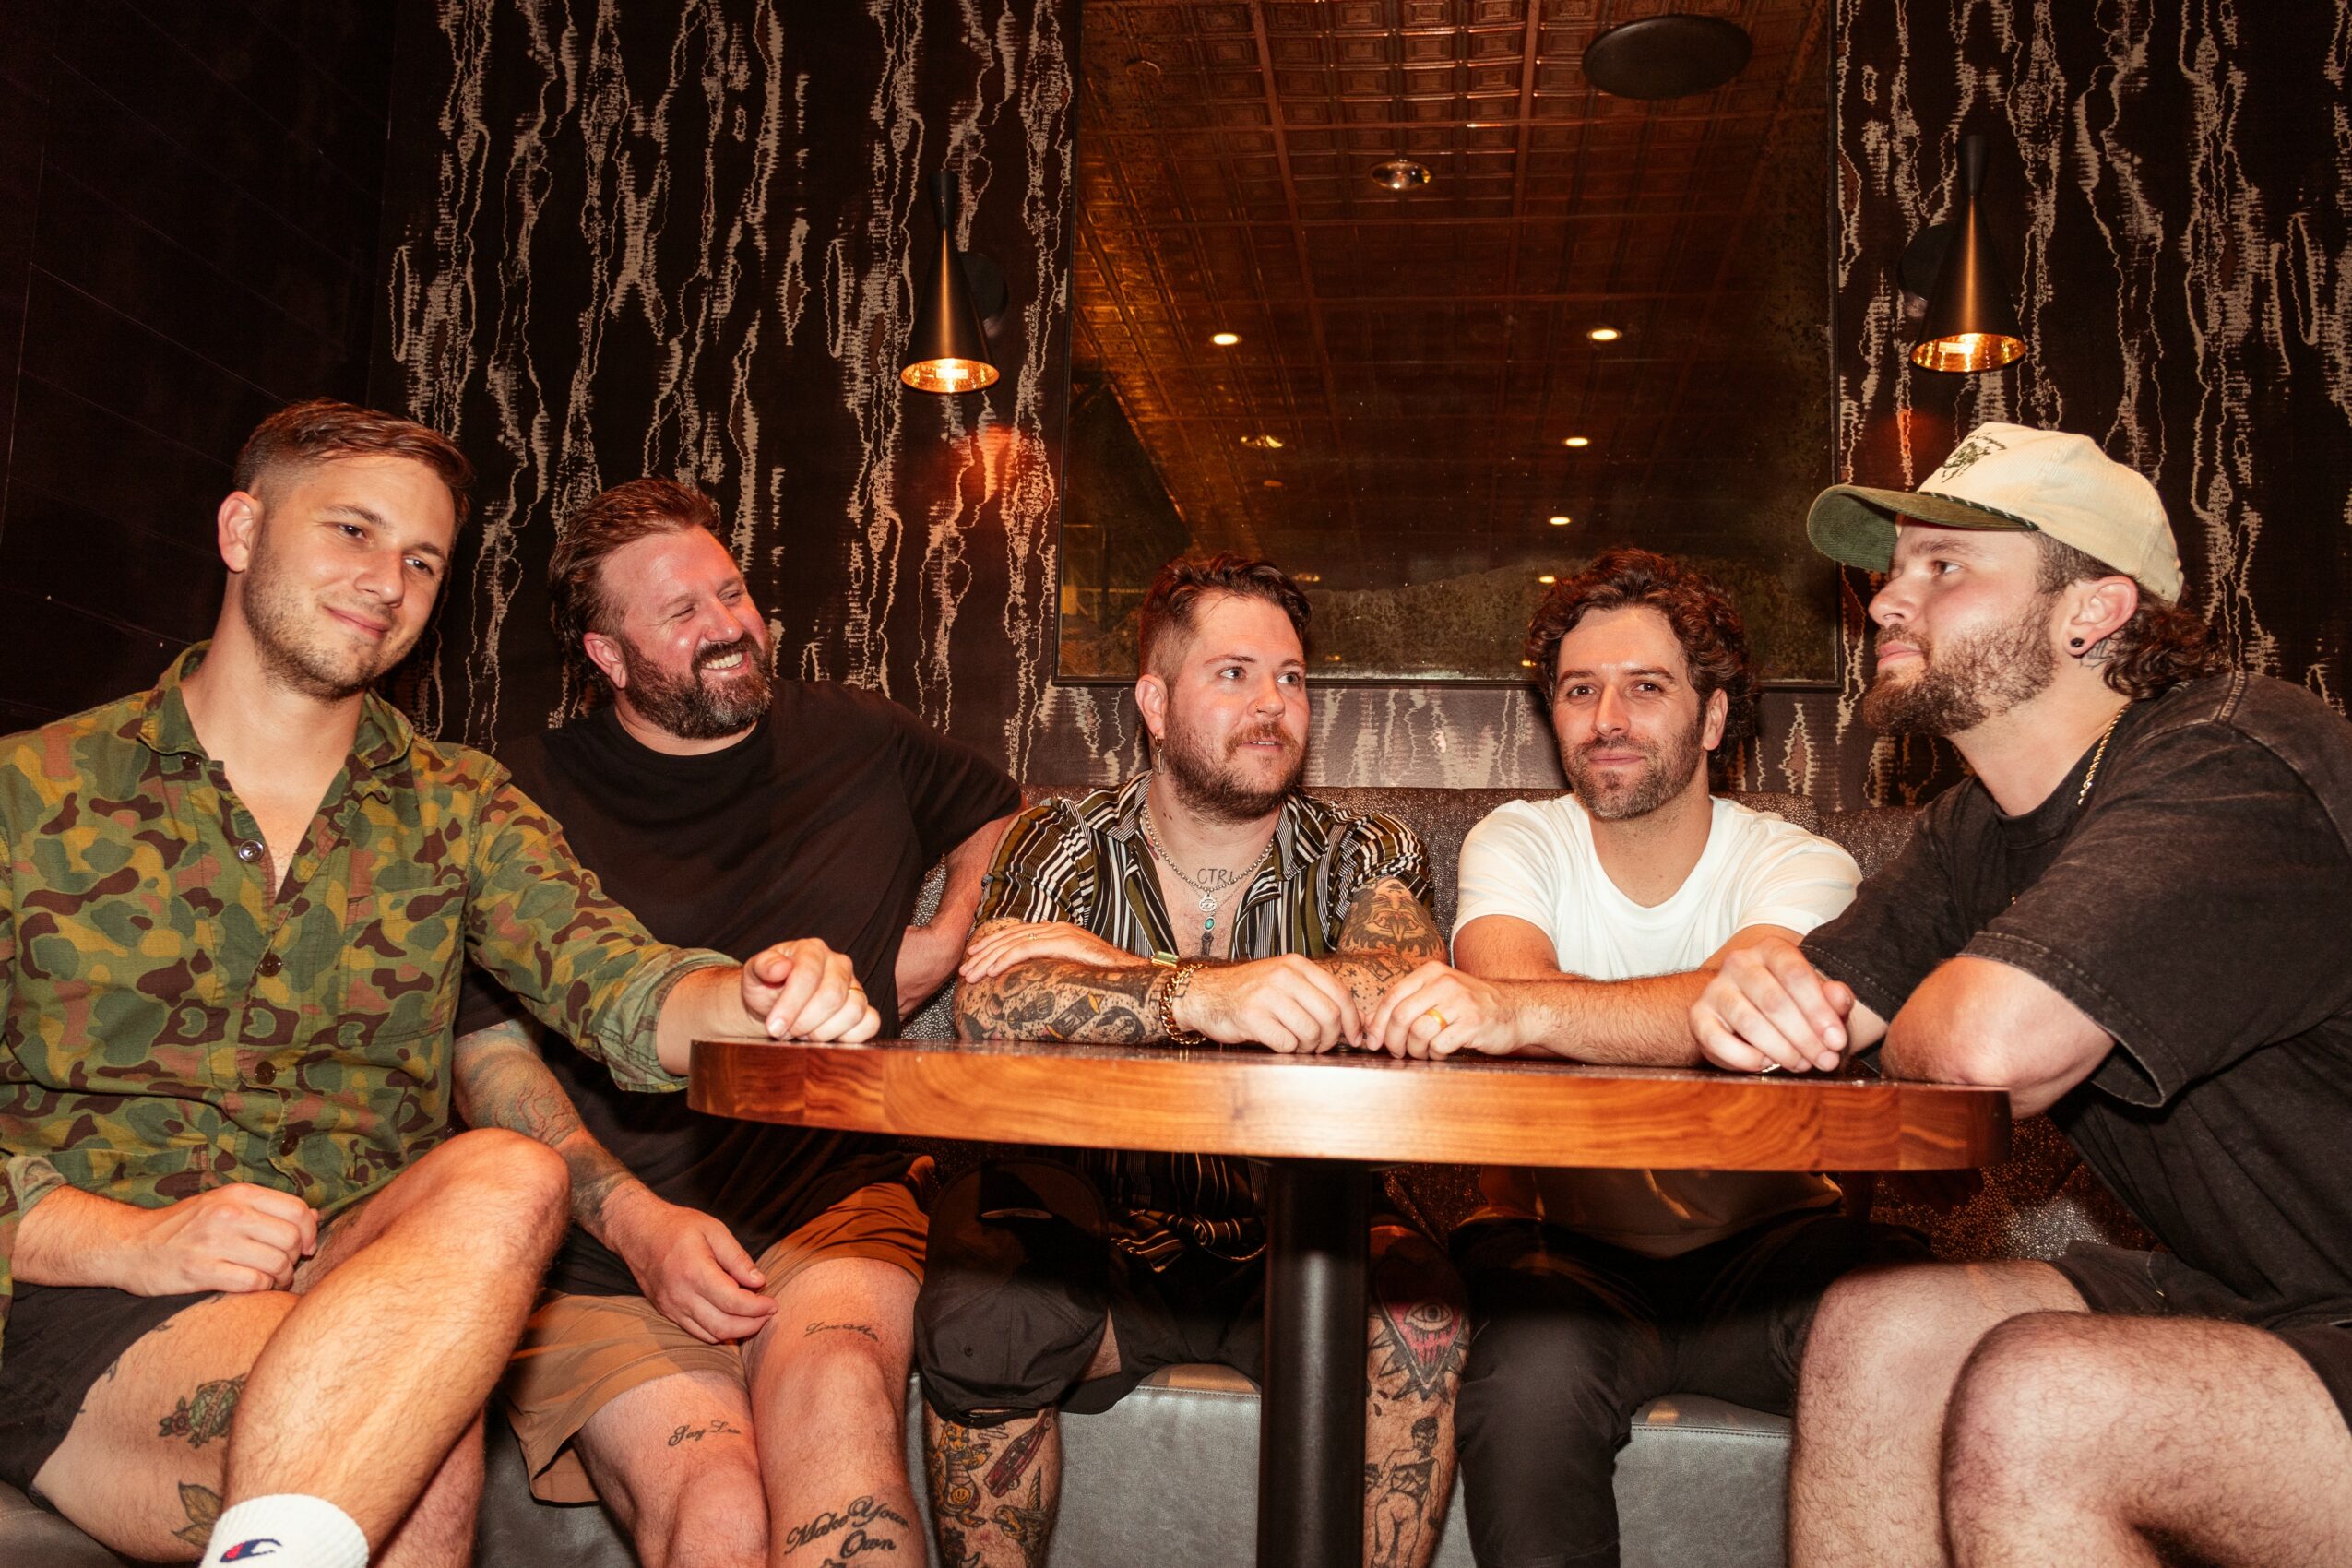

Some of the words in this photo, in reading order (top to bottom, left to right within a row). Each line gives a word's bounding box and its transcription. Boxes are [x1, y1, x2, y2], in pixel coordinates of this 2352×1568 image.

[784, 1512, 849, 1555] Make
[848, 1495, 909, 1527] Your
[840, 1529, 897, 1559] Own
